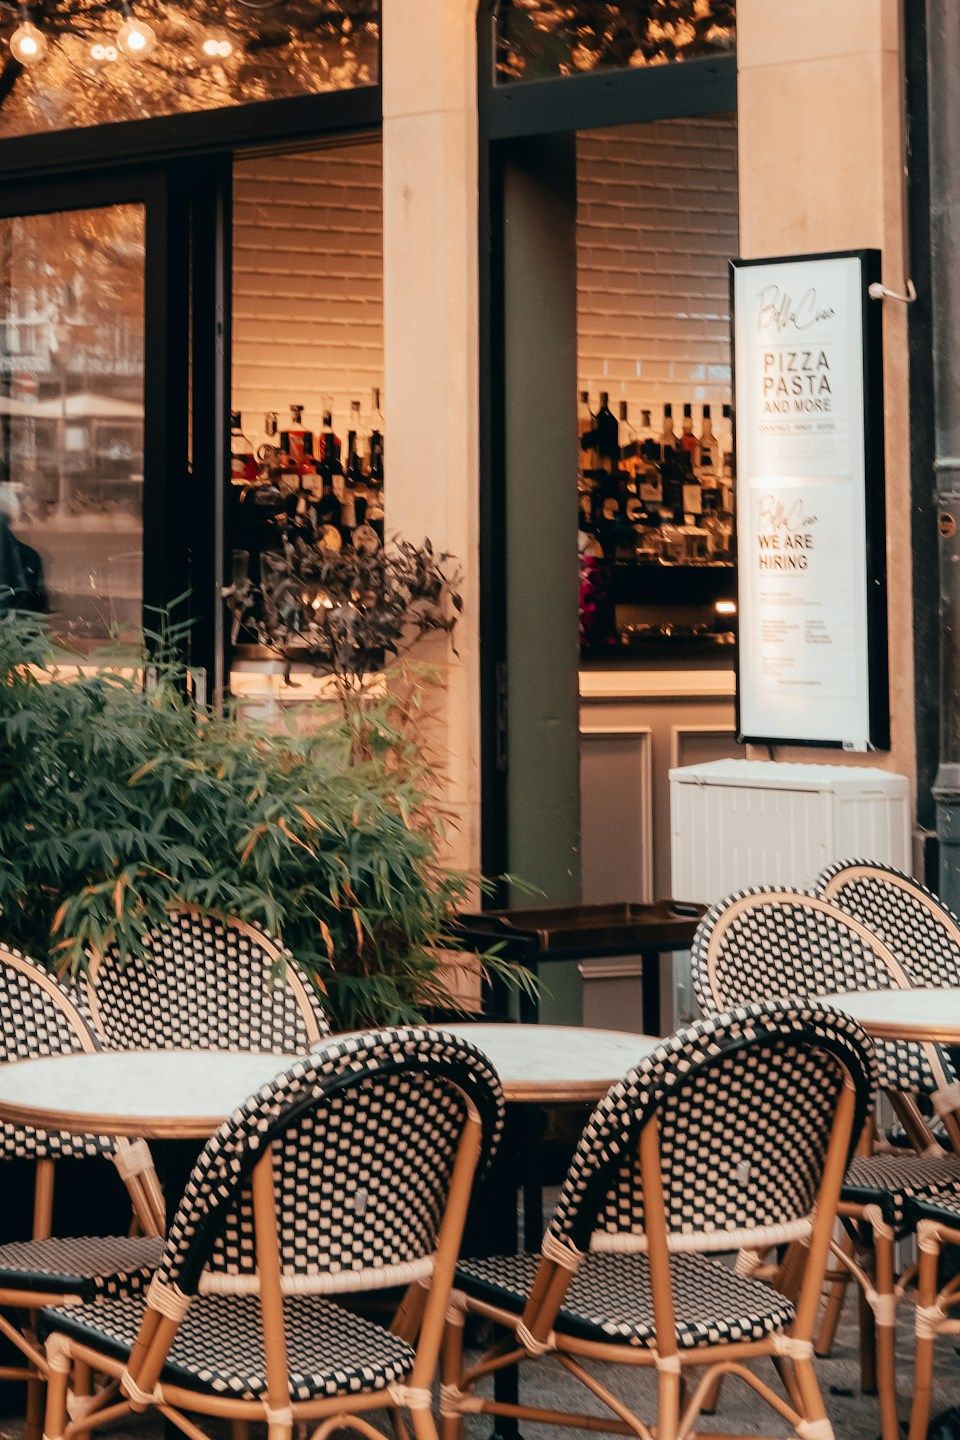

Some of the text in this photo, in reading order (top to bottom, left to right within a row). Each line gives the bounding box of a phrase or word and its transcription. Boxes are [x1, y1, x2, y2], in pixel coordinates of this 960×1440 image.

[763, 350, 830, 373] PIZZA
[763, 374, 832, 398] PASTA
[763, 398, 831, 414] AND MORE
[757, 533, 814, 551] WE ARE
[758, 554, 809, 571] HIRING
